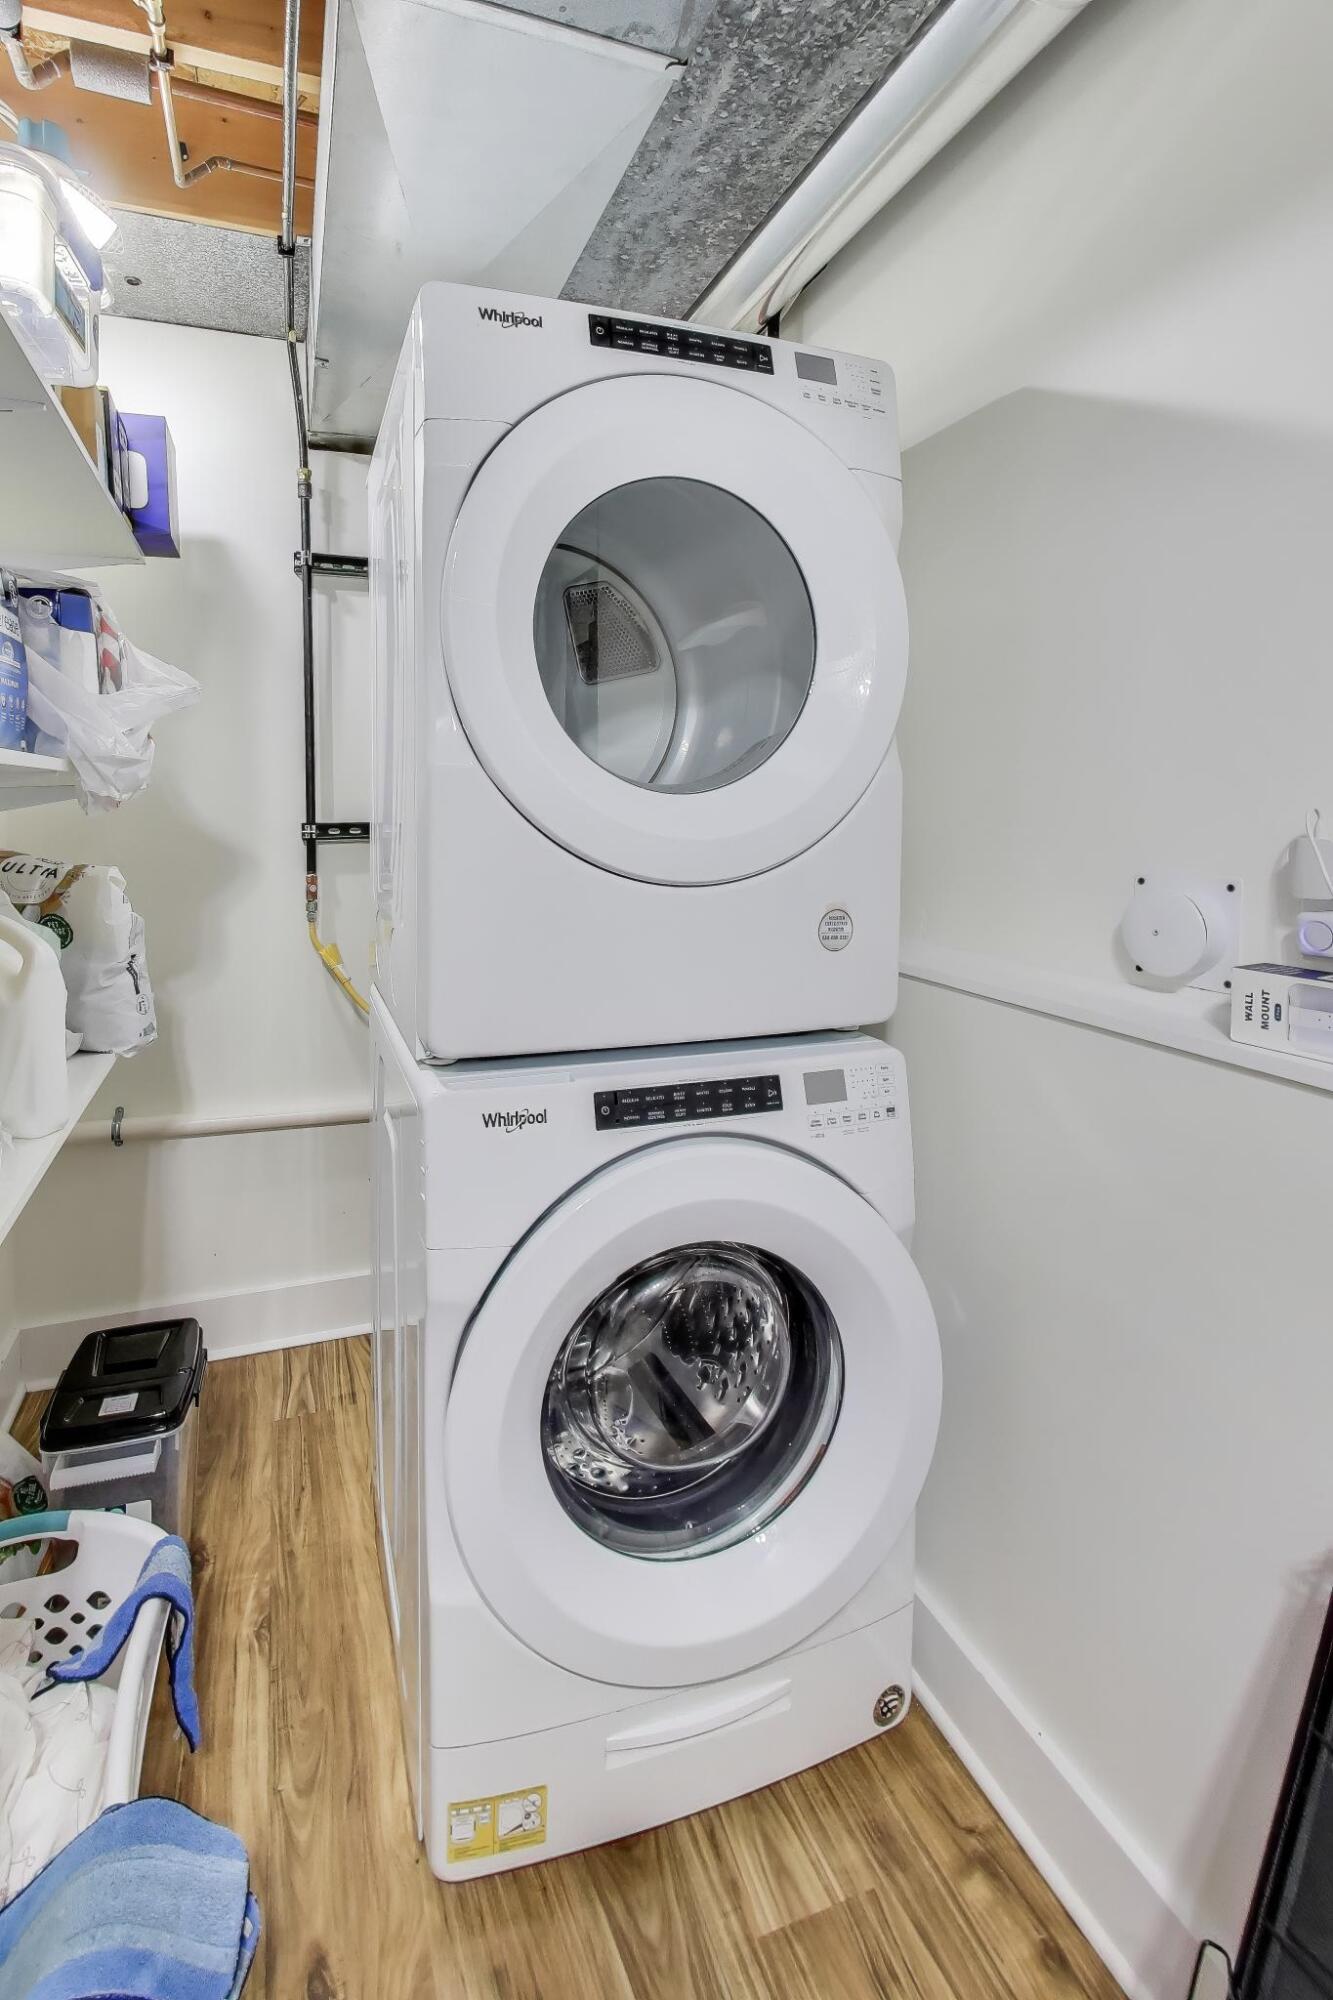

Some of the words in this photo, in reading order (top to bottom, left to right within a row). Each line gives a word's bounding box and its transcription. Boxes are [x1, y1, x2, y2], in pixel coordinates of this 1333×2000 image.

[478, 306, 543, 329] Whirlpool
[1244, 992, 1254, 1022] WALL
[1261, 989, 1271, 1030] MOUNT
[482, 1108, 547, 1133] Whirlpool
